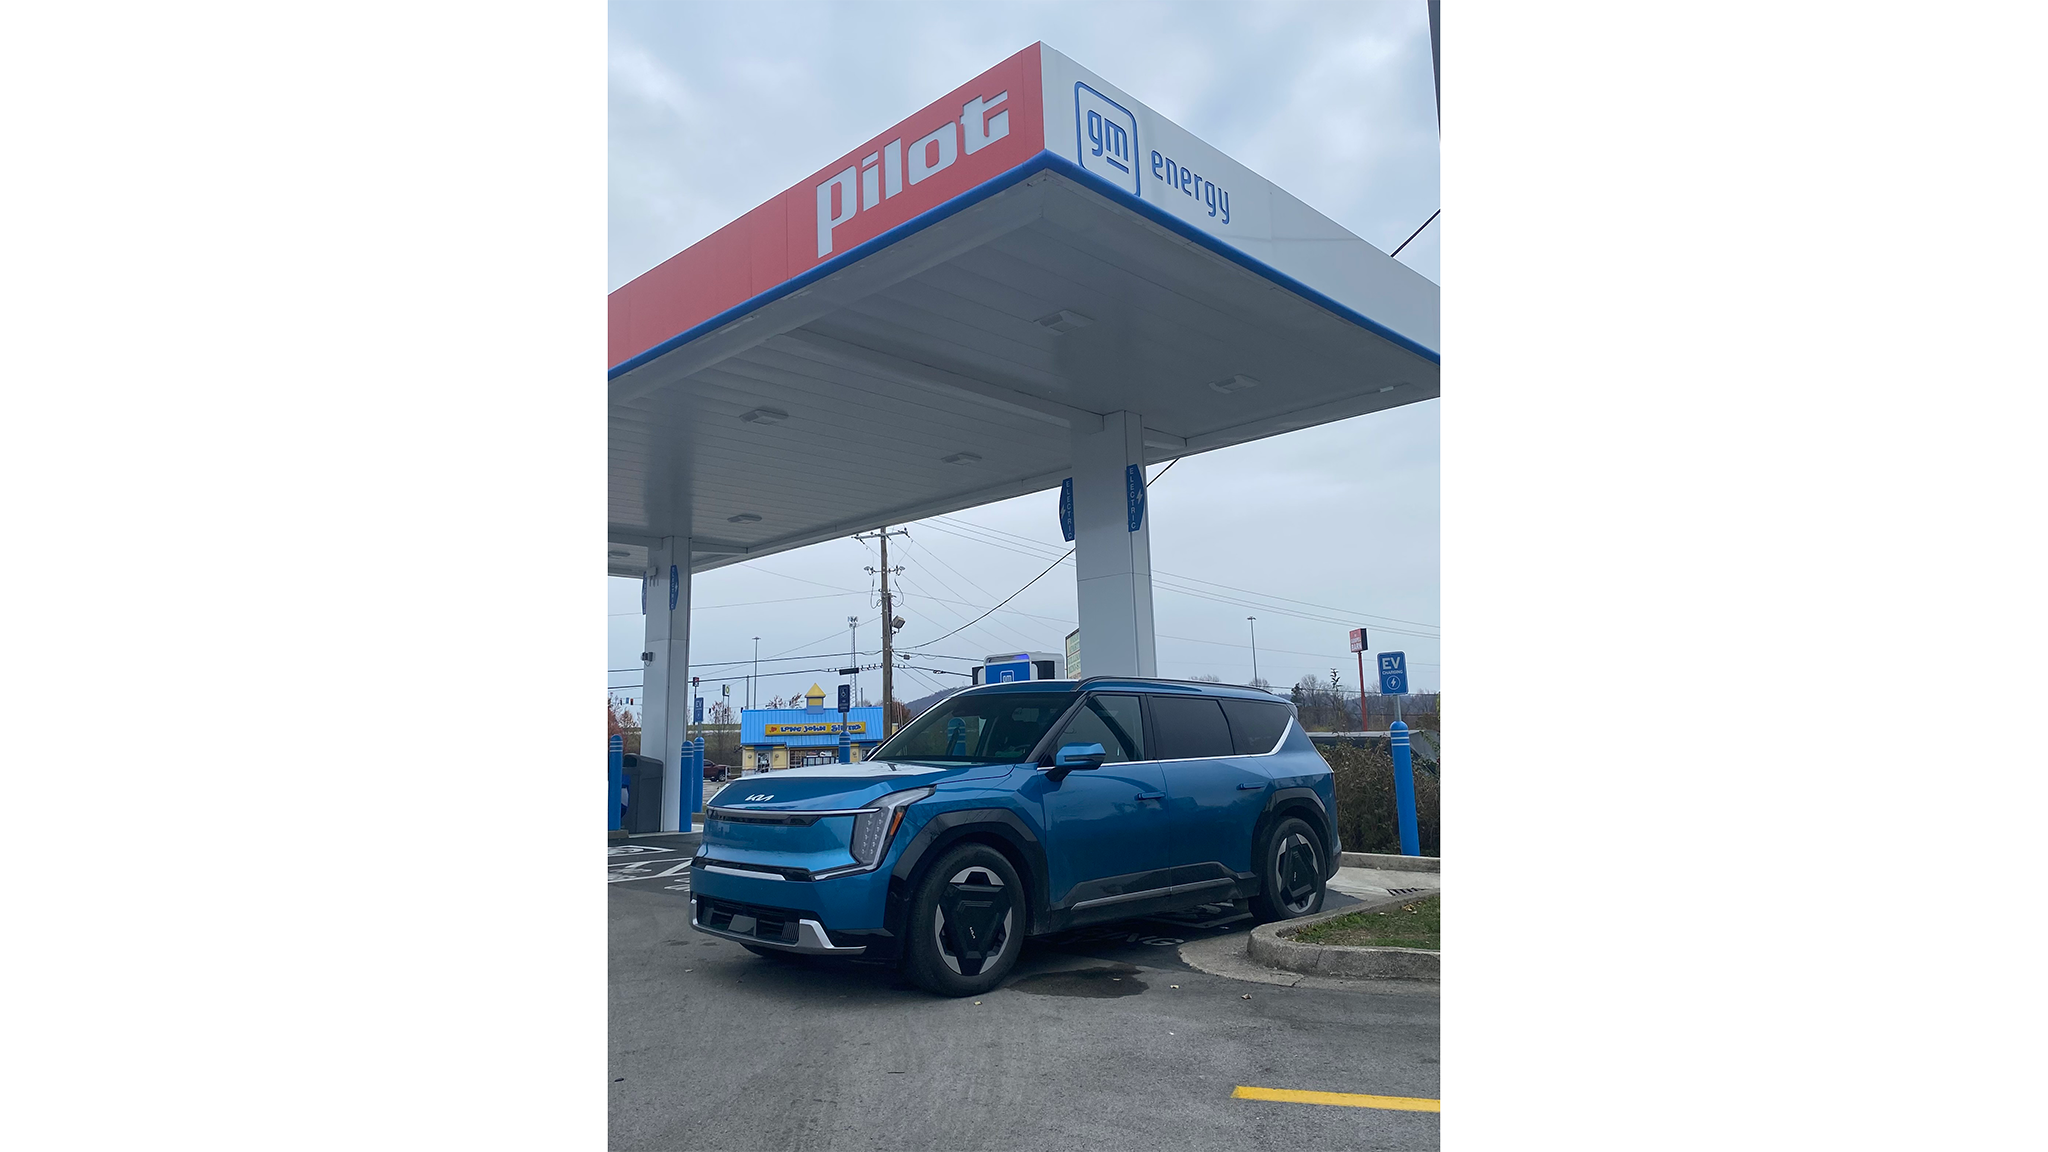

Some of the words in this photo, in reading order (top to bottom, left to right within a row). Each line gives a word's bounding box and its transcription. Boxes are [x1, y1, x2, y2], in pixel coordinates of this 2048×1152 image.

[1087, 109, 1129, 162] gm
[1151, 149, 1230, 225] energy
[1129, 467, 1137, 530] ELECTRIC
[1382, 657, 1400, 669] EV
